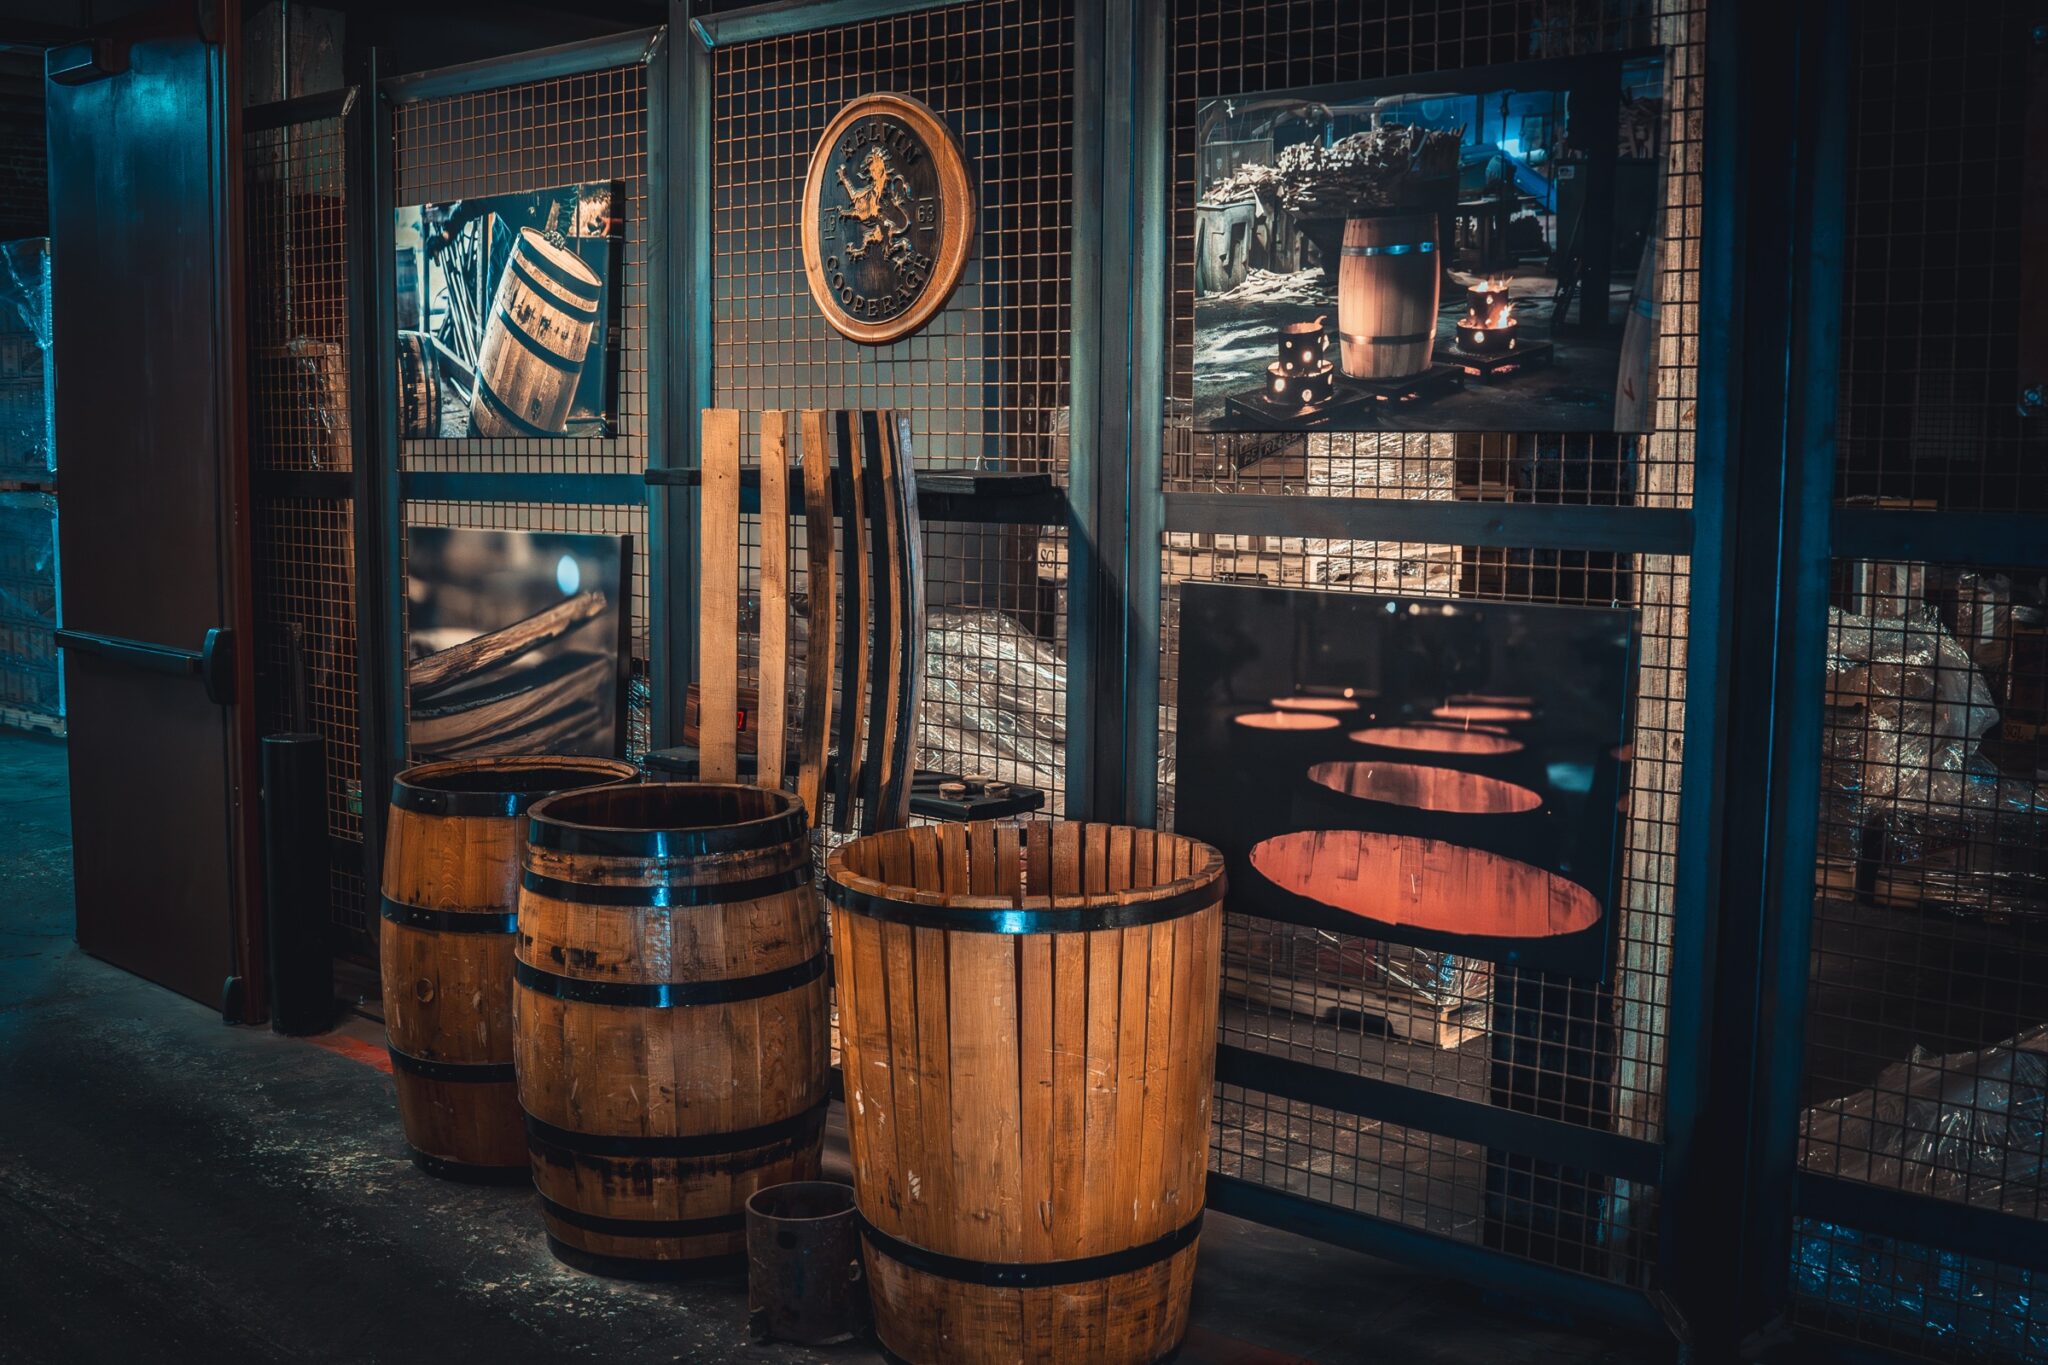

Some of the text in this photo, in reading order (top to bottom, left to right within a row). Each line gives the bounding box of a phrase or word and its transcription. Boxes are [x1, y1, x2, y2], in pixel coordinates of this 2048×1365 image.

[840, 122, 922, 164] KELVIN
[824, 204, 936, 231] 19 63
[827, 253, 932, 317] COOPERAGE
